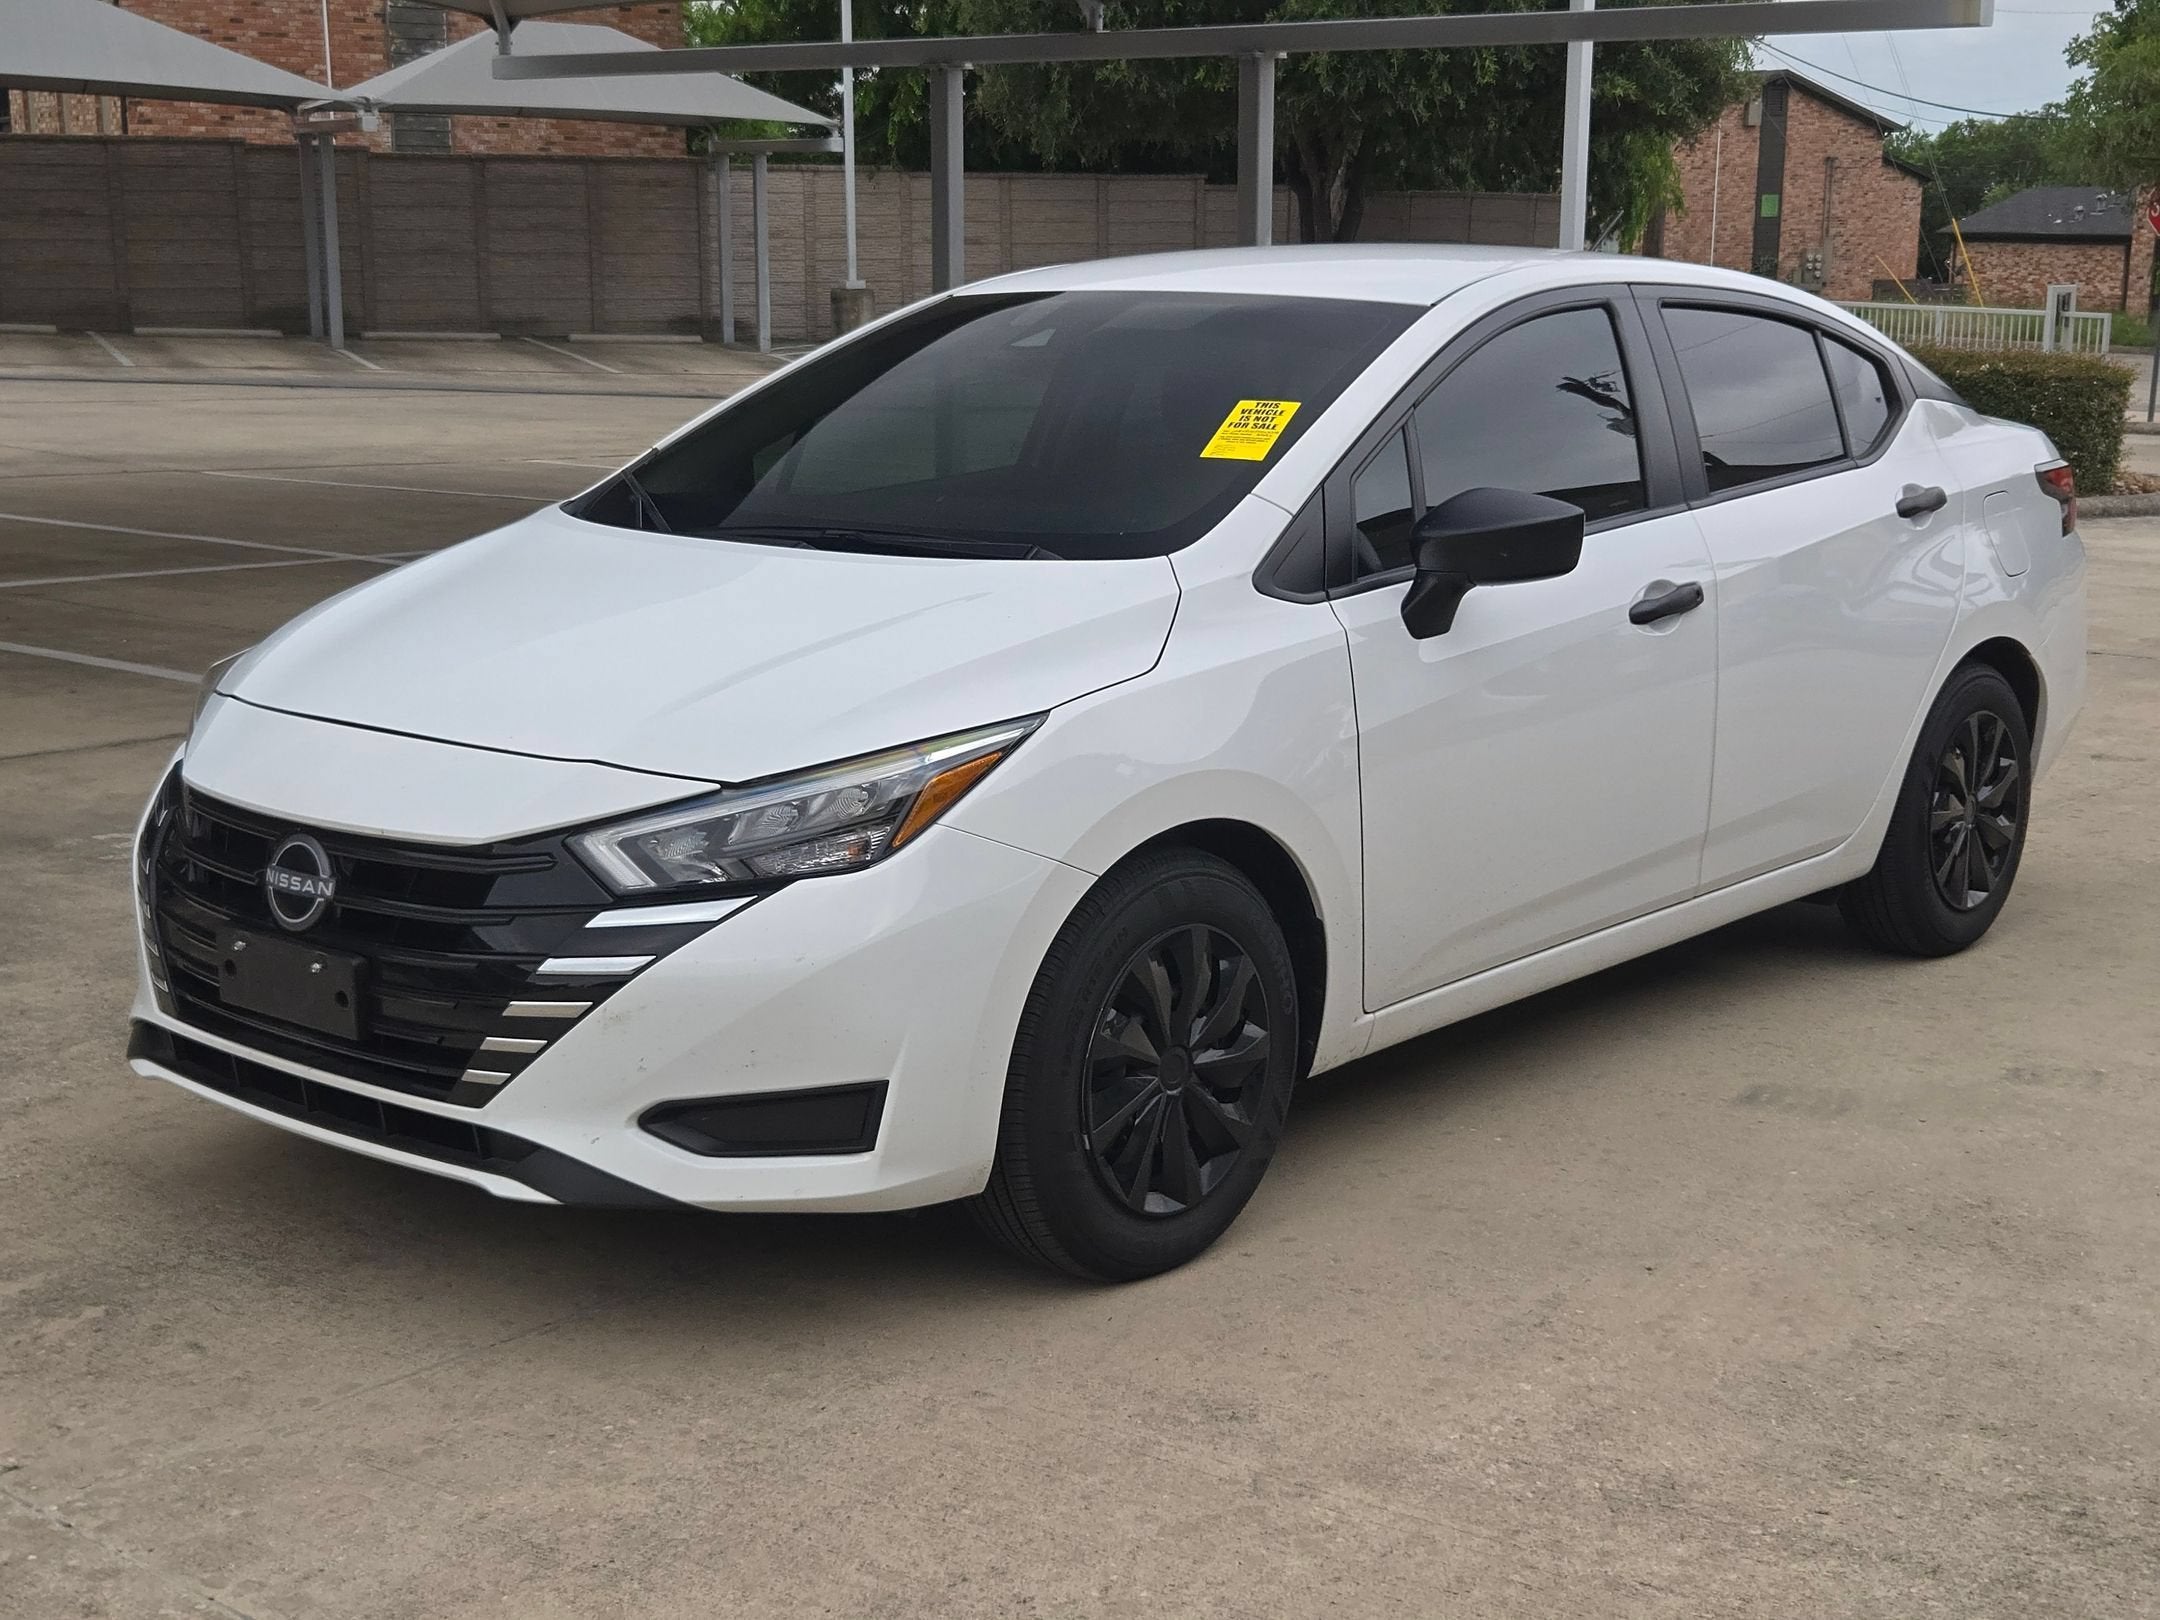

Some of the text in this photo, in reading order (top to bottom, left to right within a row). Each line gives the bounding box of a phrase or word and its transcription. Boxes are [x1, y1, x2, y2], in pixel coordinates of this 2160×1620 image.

[1240, 408, 1285, 416] VEHICLE
[1253, 415, 1277, 423] NOT
[1251, 422, 1279, 430] SALE
[266, 867, 334, 896] NISSAN
